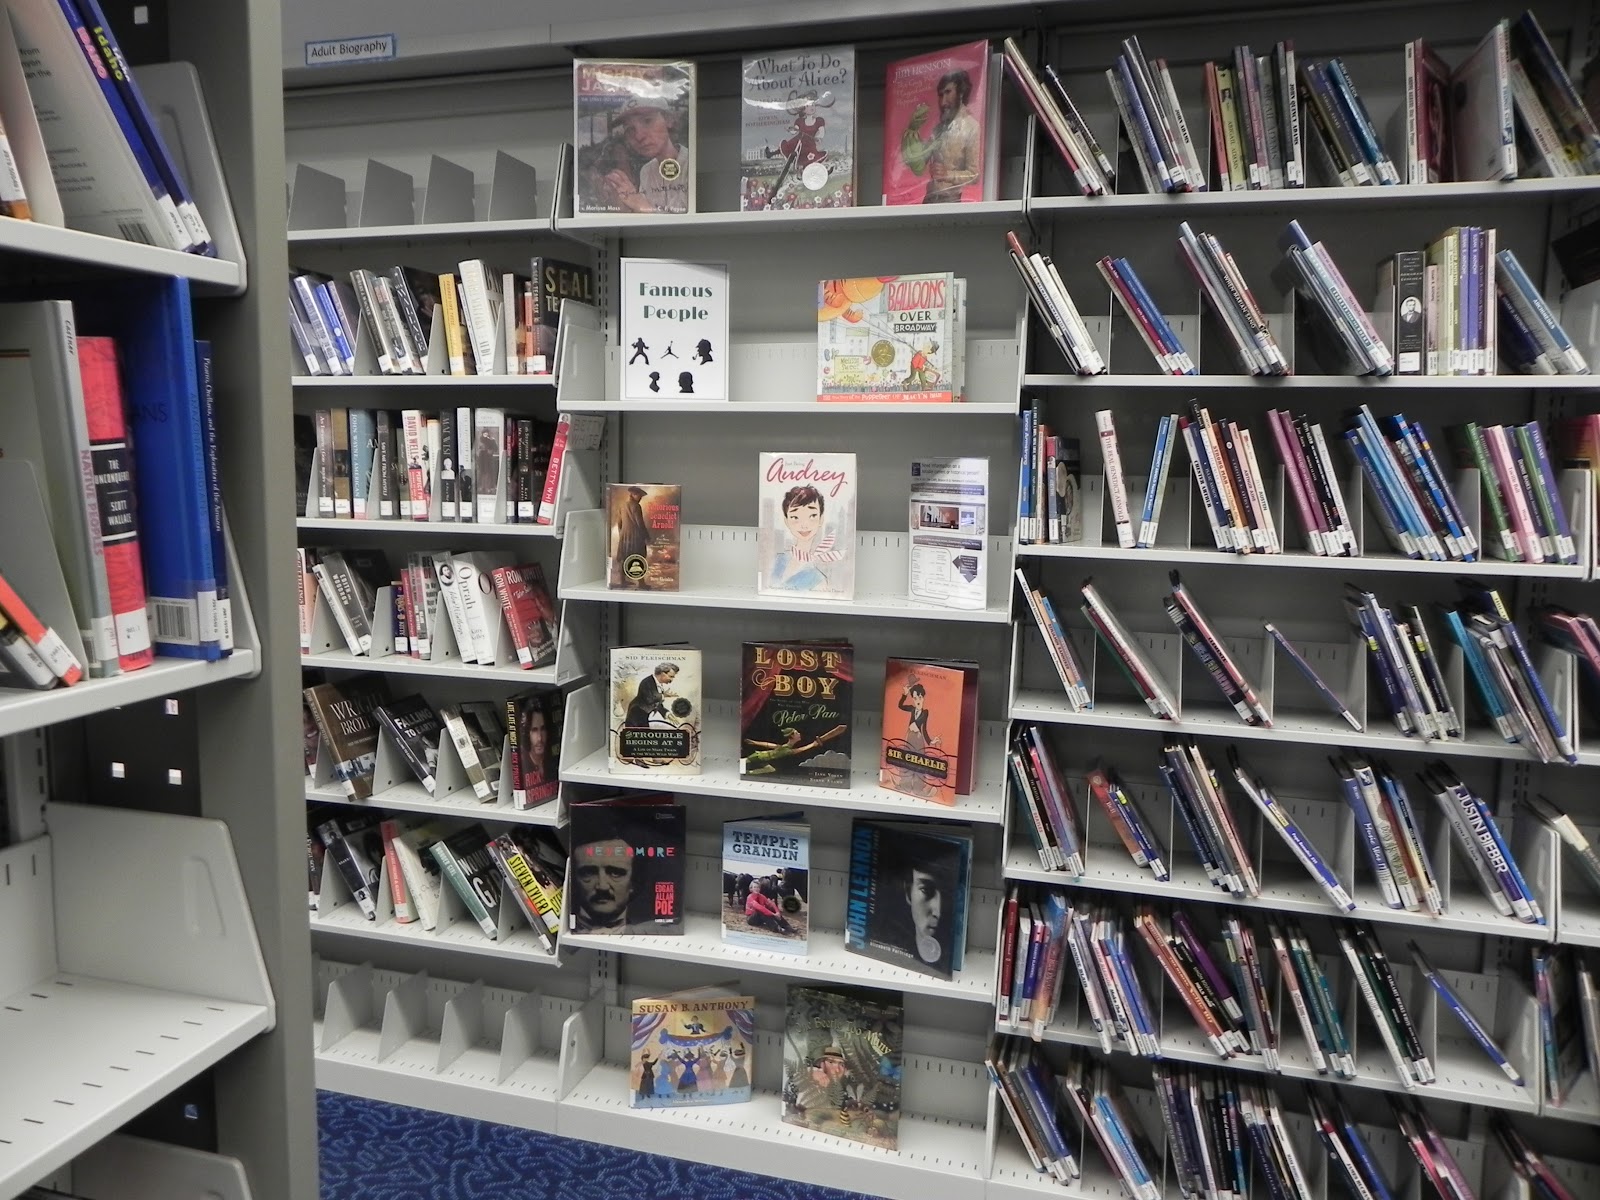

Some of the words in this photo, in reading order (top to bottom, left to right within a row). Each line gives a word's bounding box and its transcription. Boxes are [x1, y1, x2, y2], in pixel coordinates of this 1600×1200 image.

[94, 26, 123, 81] Idaho
[311, 44, 337, 58] Adult
[339, 40, 388, 56] Biography
[756, 57, 797, 75] What
[797, 54, 816, 71] To
[820, 52, 841, 70] Do
[749, 75, 797, 92] About
[798, 67, 848, 87] Alice?
[1338, 61, 1346, 72] BEN
[1344, 71, 1358, 98] AFFLECK
[1264, 82, 1275, 123] ABIGAIL
[1290, 100, 1298, 124] QUINCY
[1174, 108, 1184, 123] JOHN
[1180, 123, 1190, 145] ADAMS
[1227, 120, 1237, 146] ABIGAIL
[1266, 126, 1277, 160] ADAMS
[1231, 147, 1239, 171] ADAMS
[544, 265, 594, 299] SEAL
[639, 282, 714, 298] Famous
[887, 279, 947, 312] BALLOONS
[1222, 274, 1235, 293] WHEN
[1232, 289, 1248, 315] MARIAN
[1243, 312, 1256, 330] SANG
[643, 304, 709, 323] People
[899, 310, 933, 322] OVER
[1532, 298, 1555, 330] ARCHIMEDES
[65, 319, 75, 356] Castner
[894, 322, 937, 333] BROADWAY
[207, 416, 216, 432] and
[351, 413, 359, 434] JOHN
[406, 415, 417, 438] DAVID
[1023, 411, 1031, 432] Lance
[408, 438, 420, 461] WELLS
[1022, 432, 1031, 466] Armstrong
[1106, 448, 1114, 463] REAL
[80, 449, 96, 499] NATIVE
[108, 459, 120, 471] THE
[209, 443, 219, 485] Exploration
[550, 457, 561, 485] BETTY
[1212, 445, 1223, 468] STRONG
[1220, 469, 1229, 486] MAN
[1508, 466, 1517, 483] Lucille
[353, 457, 361, 497] AMERICAN
[766, 456, 848, 498] Audrey
[1109, 464, 1120, 495] BENEDICT
[1193, 459, 1204, 487] CHESTER
[1201, 486, 1212, 508] ARTHUR
[1522, 472, 1531, 491] BANKS
[110, 499, 128, 512] SCOTT
[213, 492, 221, 504] the
[545, 485, 555, 504] WHI
[1258, 490, 1268, 511] AUSTEN
[107, 512, 133, 526] WALLACE
[650, 512, 677, 520] Benedict
[1115, 495, 1124, 521] ARNOLD
[87, 502, 103, 557] PEOPLES
[651, 519, 675, 529] Arnold
[332, 573, 350, 606] WOODROW
[339, 573, 352, 594] EDITH
[458, 566, 476, 610] Oprah
[505, 570, 523, 585] RON
[494, 573, 504, 587] RON
[499, 587, 512, 611] WHITE
[1047, 622, 1061, 646] BENJAMIN
[1056, 643, 1070, 670] BANNEKER
[754, 646, 843, 673] LOST
[772, 674, 840, 700] BOY
[393, 707, 434, 730] FALLING
[507, 713, 517, 725] LATE
[772, 708, 810, 727] Peter
[808, 703, 840, 720] Pan
[404, 728, 417, 738] TO
[510, 731, 518, 746] NIGHT
[632, 731, 684, 739] TROUBLE
[887, 747, 903, 760] SIR
[904, 753, 948, 772] CHARLIE
[525, 771, 544, 787] RICK
[1105, 800, 1117, 815] Bell
[1032, 811, 1043, 833] BEATLES
[1456, 791, 1485, 834] JUSTIN
[1478, 830, 1508, 874] BIEBER
[586, 846, 675, 858] NEVERMORE
[732, 830, 799, 851] TEMPLE
[732, 843, 799, 862] GRANDIN
[1291, 831, 1300, 842] Pope
[1298, 839, 1312, 859] Benedict
[1309, 856, 1319, 866] XVI
[1363, 822, 1376, 845] Music
[1372, 845, 1382, 863] Was
[434, 847, 451, 865] WONDER
[446, 863, 457, 877] GIRL
[850, 826, 873, 898] LENNON
[509, 856, 534, 888] STEVEN
[527, 886, 549, 913] TYLER
[655, 884, 674, 893] EDGAR
[655, 892, 674, 900] ALLAN
[654, 900, 674, 916] POE
[848, 899, 868, 950] JOHN
[1070, 942, 1082, 968] BONNIE
[1079, 967, 1088, 989] BLAIR
[639, 1003, 679, 1014] SUSAN
[681, 1002, 691, 1012] B.
[692, 1001, 749, 1012] ANTHONY
[1109, 988, 1119, 1004] Make
[863, 1030, 893, 1058] Many
[1346, 1162, 1358, 1178] JAMES
